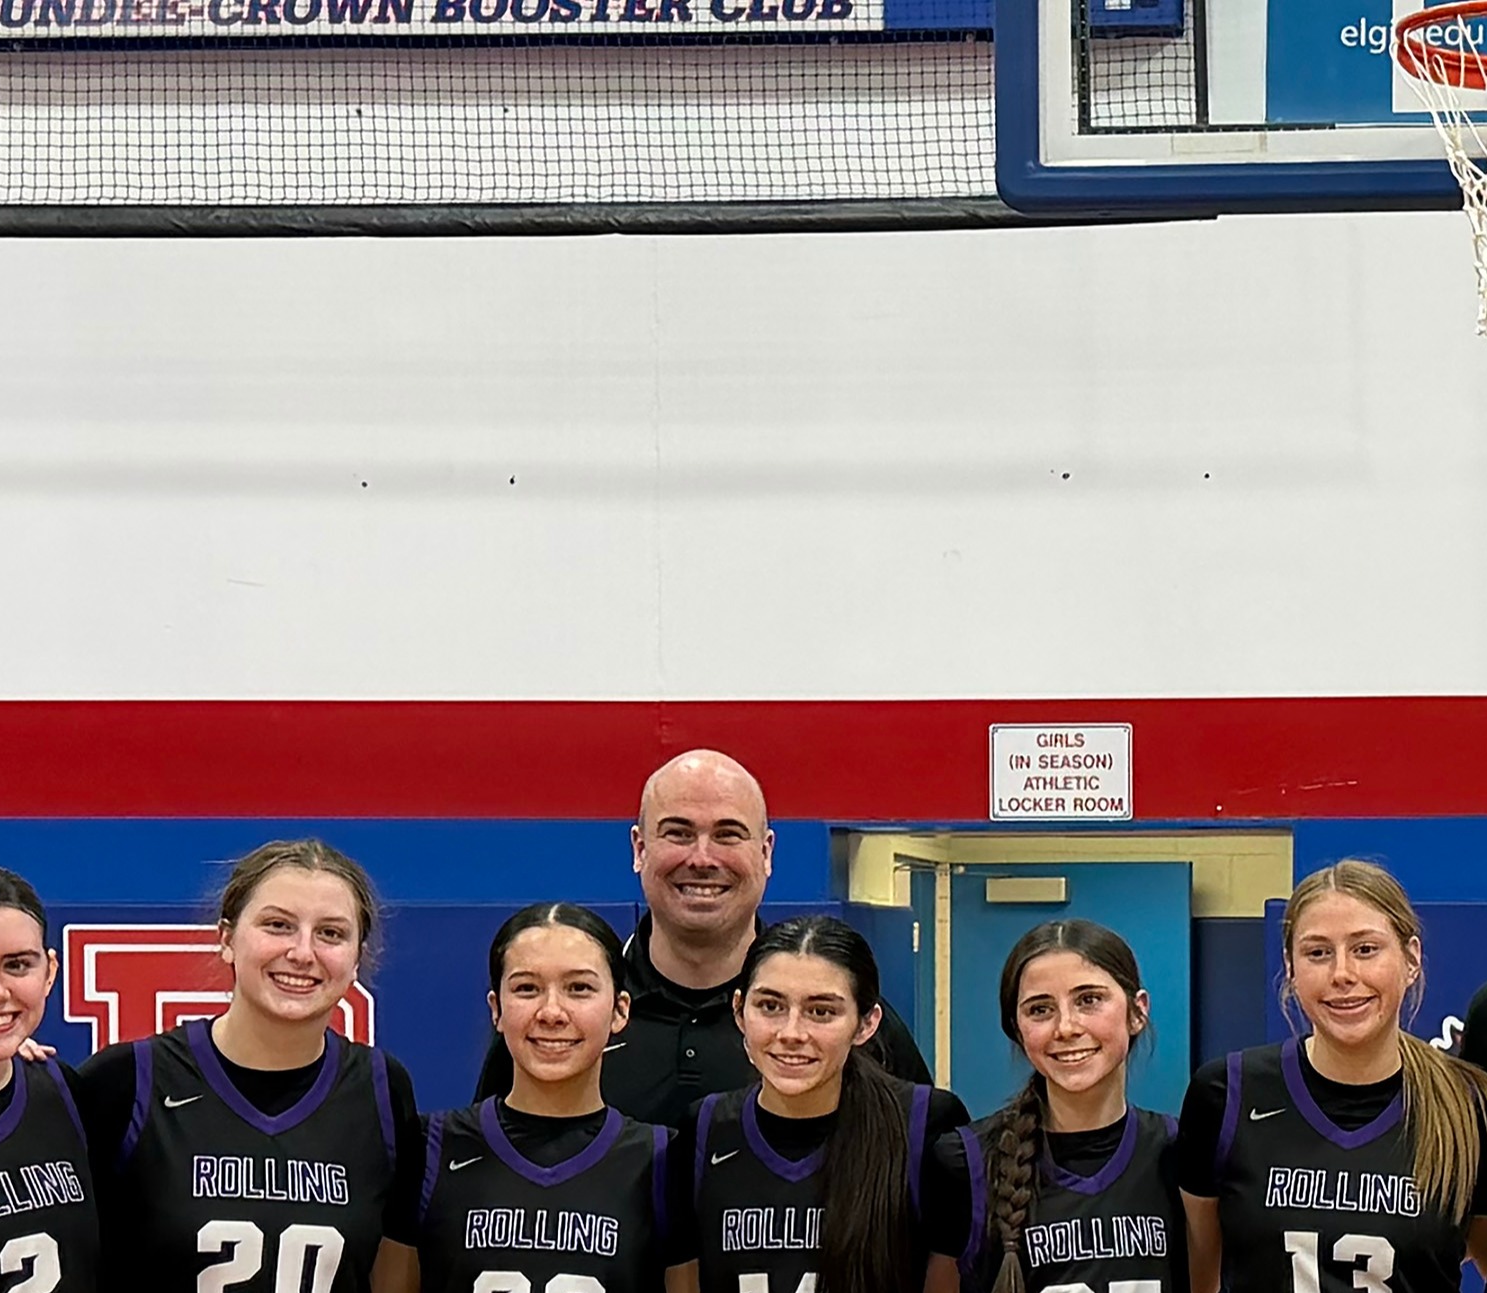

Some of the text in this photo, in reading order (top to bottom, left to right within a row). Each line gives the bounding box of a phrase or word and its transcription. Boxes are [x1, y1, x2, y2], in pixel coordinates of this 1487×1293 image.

[1009, 753, 1113, 770] (IN SEASON)
[1037, 733, 1085, 748] GIRLS
[998, 798, 1124, 812] LOCKER ROOM
[1023, 776, 1100, 791] ATHLETIC
[193, 1156, 348, 1204] ROLLING
[1265, 1166, 1421, 1218] ROLLING
[465, 1208, 619, 1256] ROLLING
[722, 1207, 823, 1251] ROLLI
[1024, 1215, 1166, 1267] ROLLING
